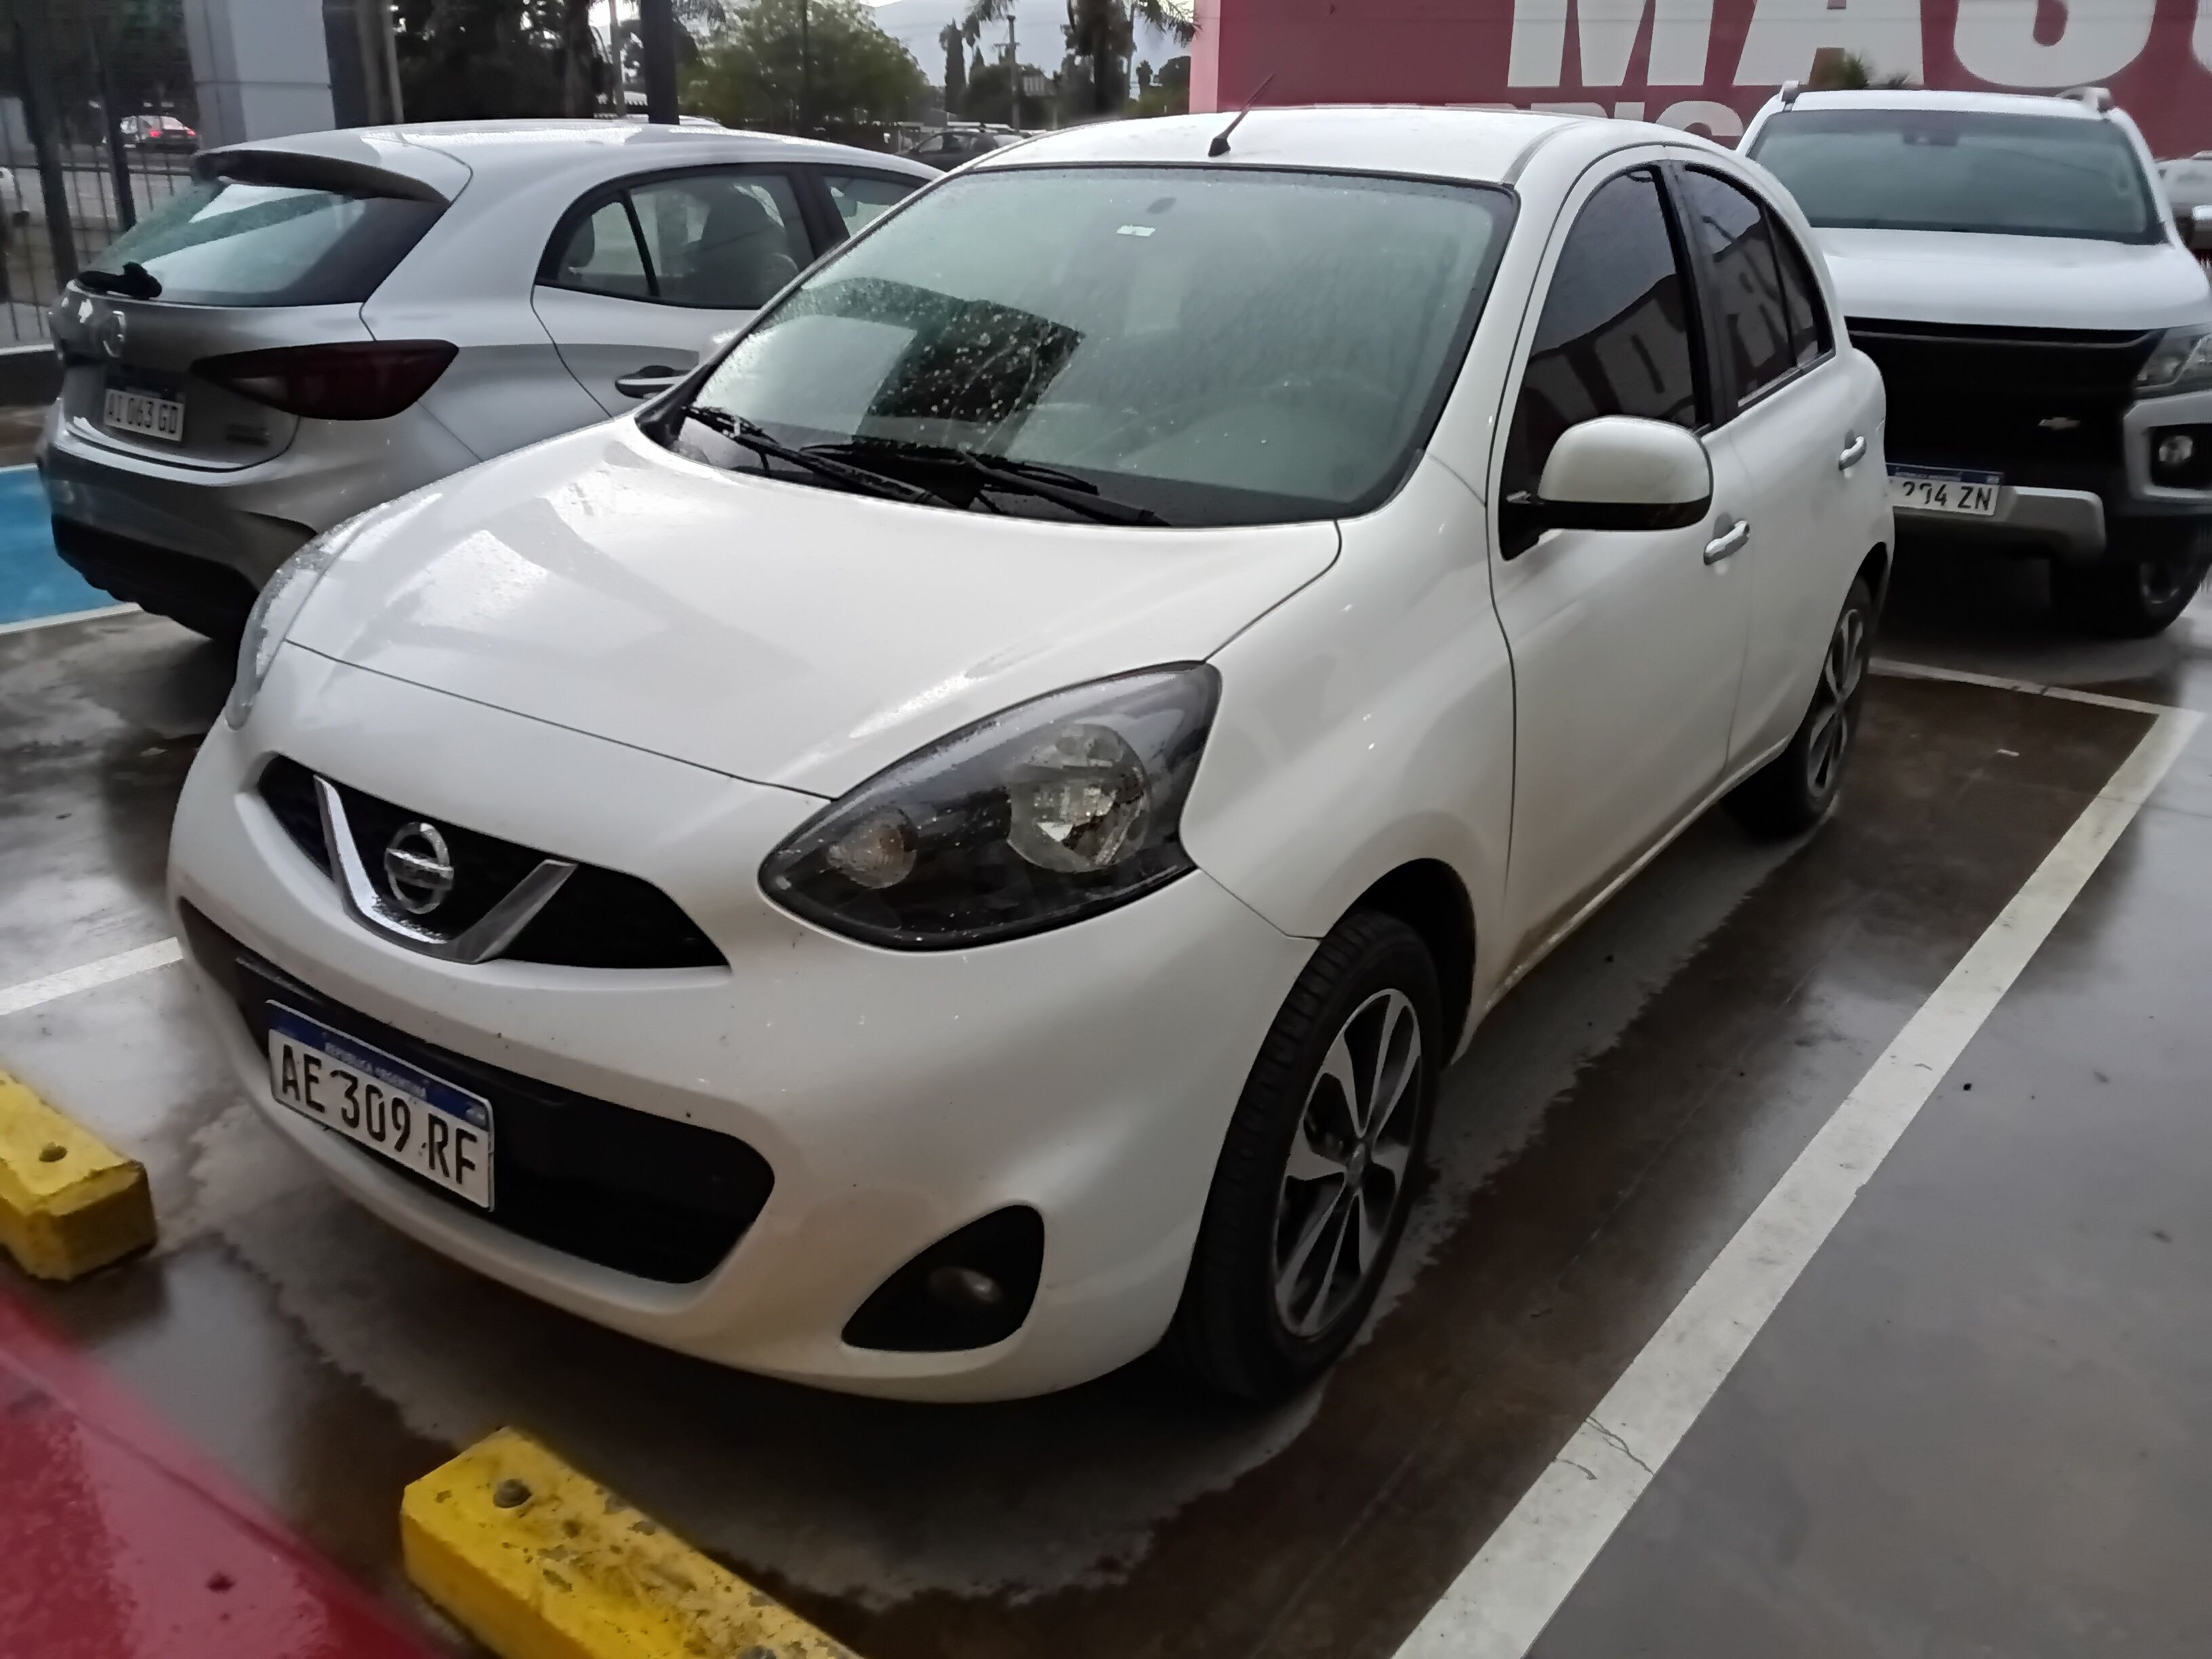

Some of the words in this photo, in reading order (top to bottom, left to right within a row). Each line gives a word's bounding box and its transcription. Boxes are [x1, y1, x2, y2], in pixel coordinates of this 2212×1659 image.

[1958, 487, 1992, 511] ZN
[282, 1044, 325, 1113] AE
[329, 1069, 411, 1152] 309
[428, 1113, 478, 1185] RF
